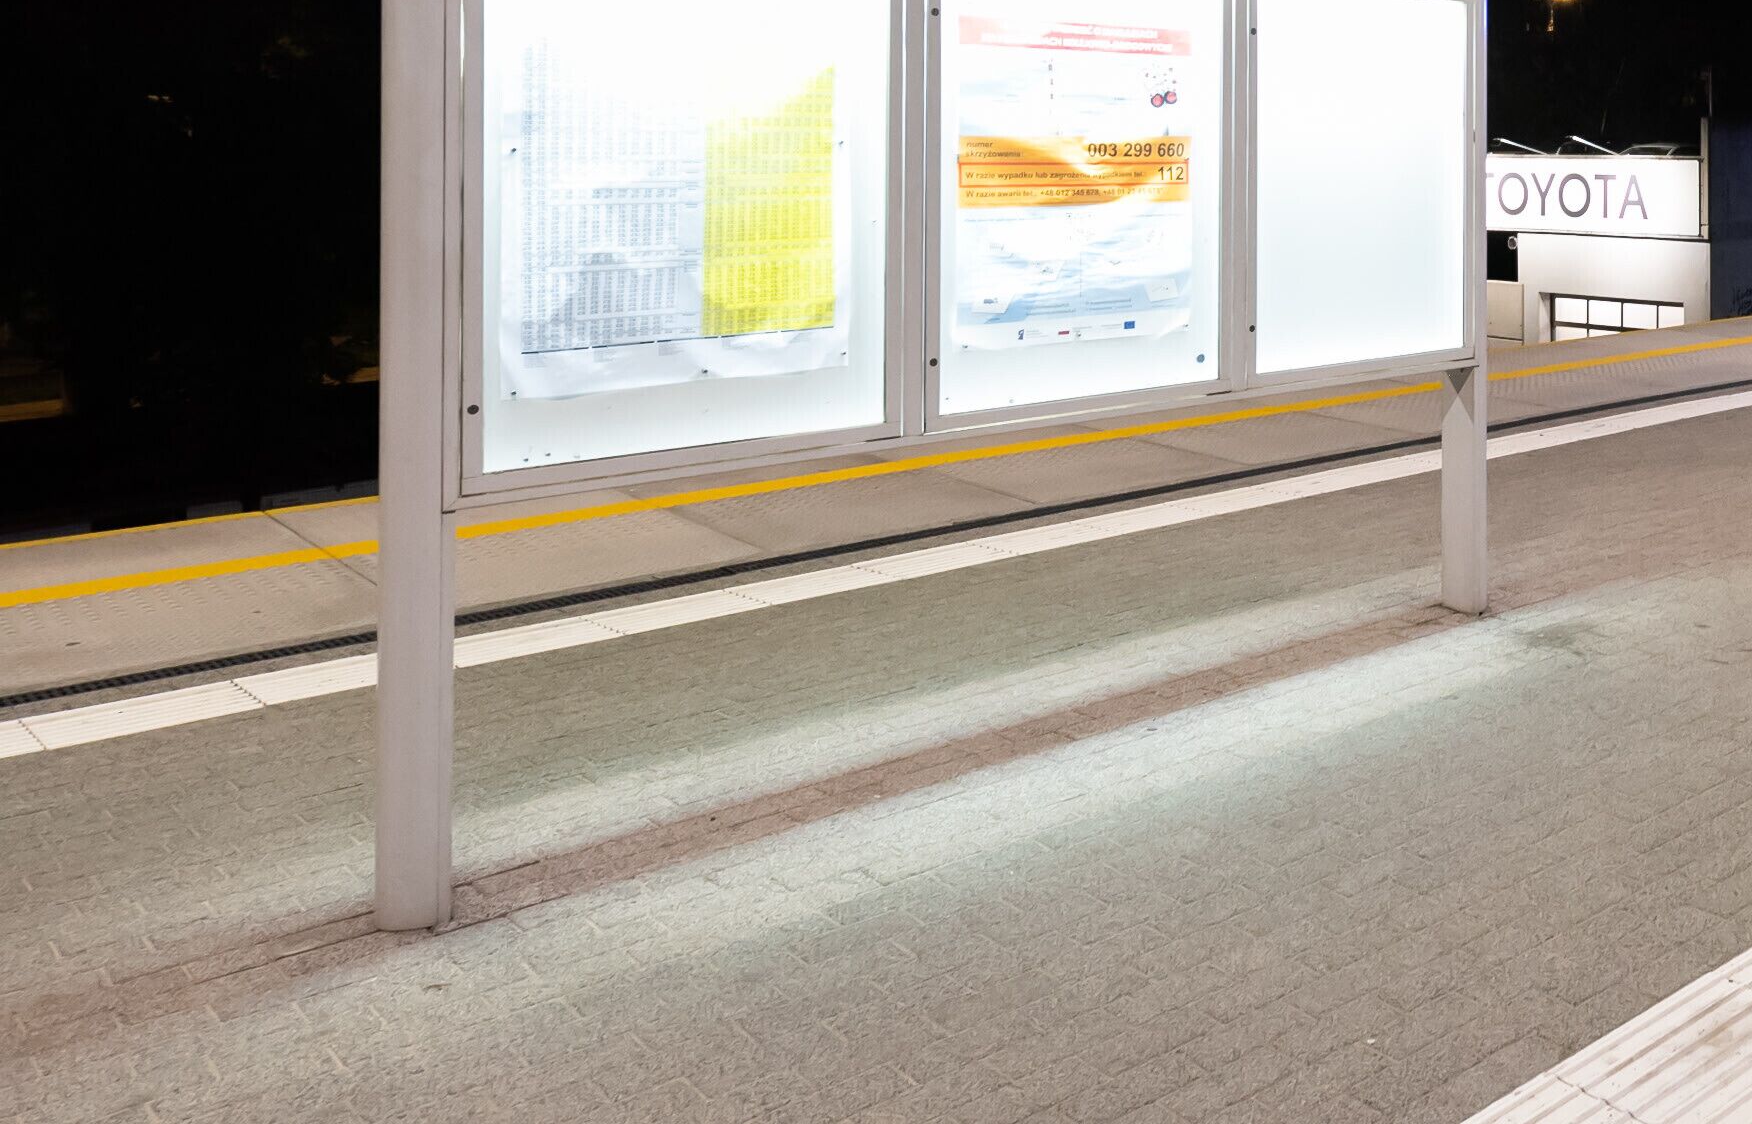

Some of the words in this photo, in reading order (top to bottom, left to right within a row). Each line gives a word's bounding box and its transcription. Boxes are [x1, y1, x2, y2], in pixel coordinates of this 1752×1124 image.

[1087, 143, 1118, 158] 003
[1123, 143, 1152, 157] 299
[1157, 143, 1185, 157] 660
[1157, 166, 1185, 181] 112
[1487, 172, 1648, 219] OYOTA
